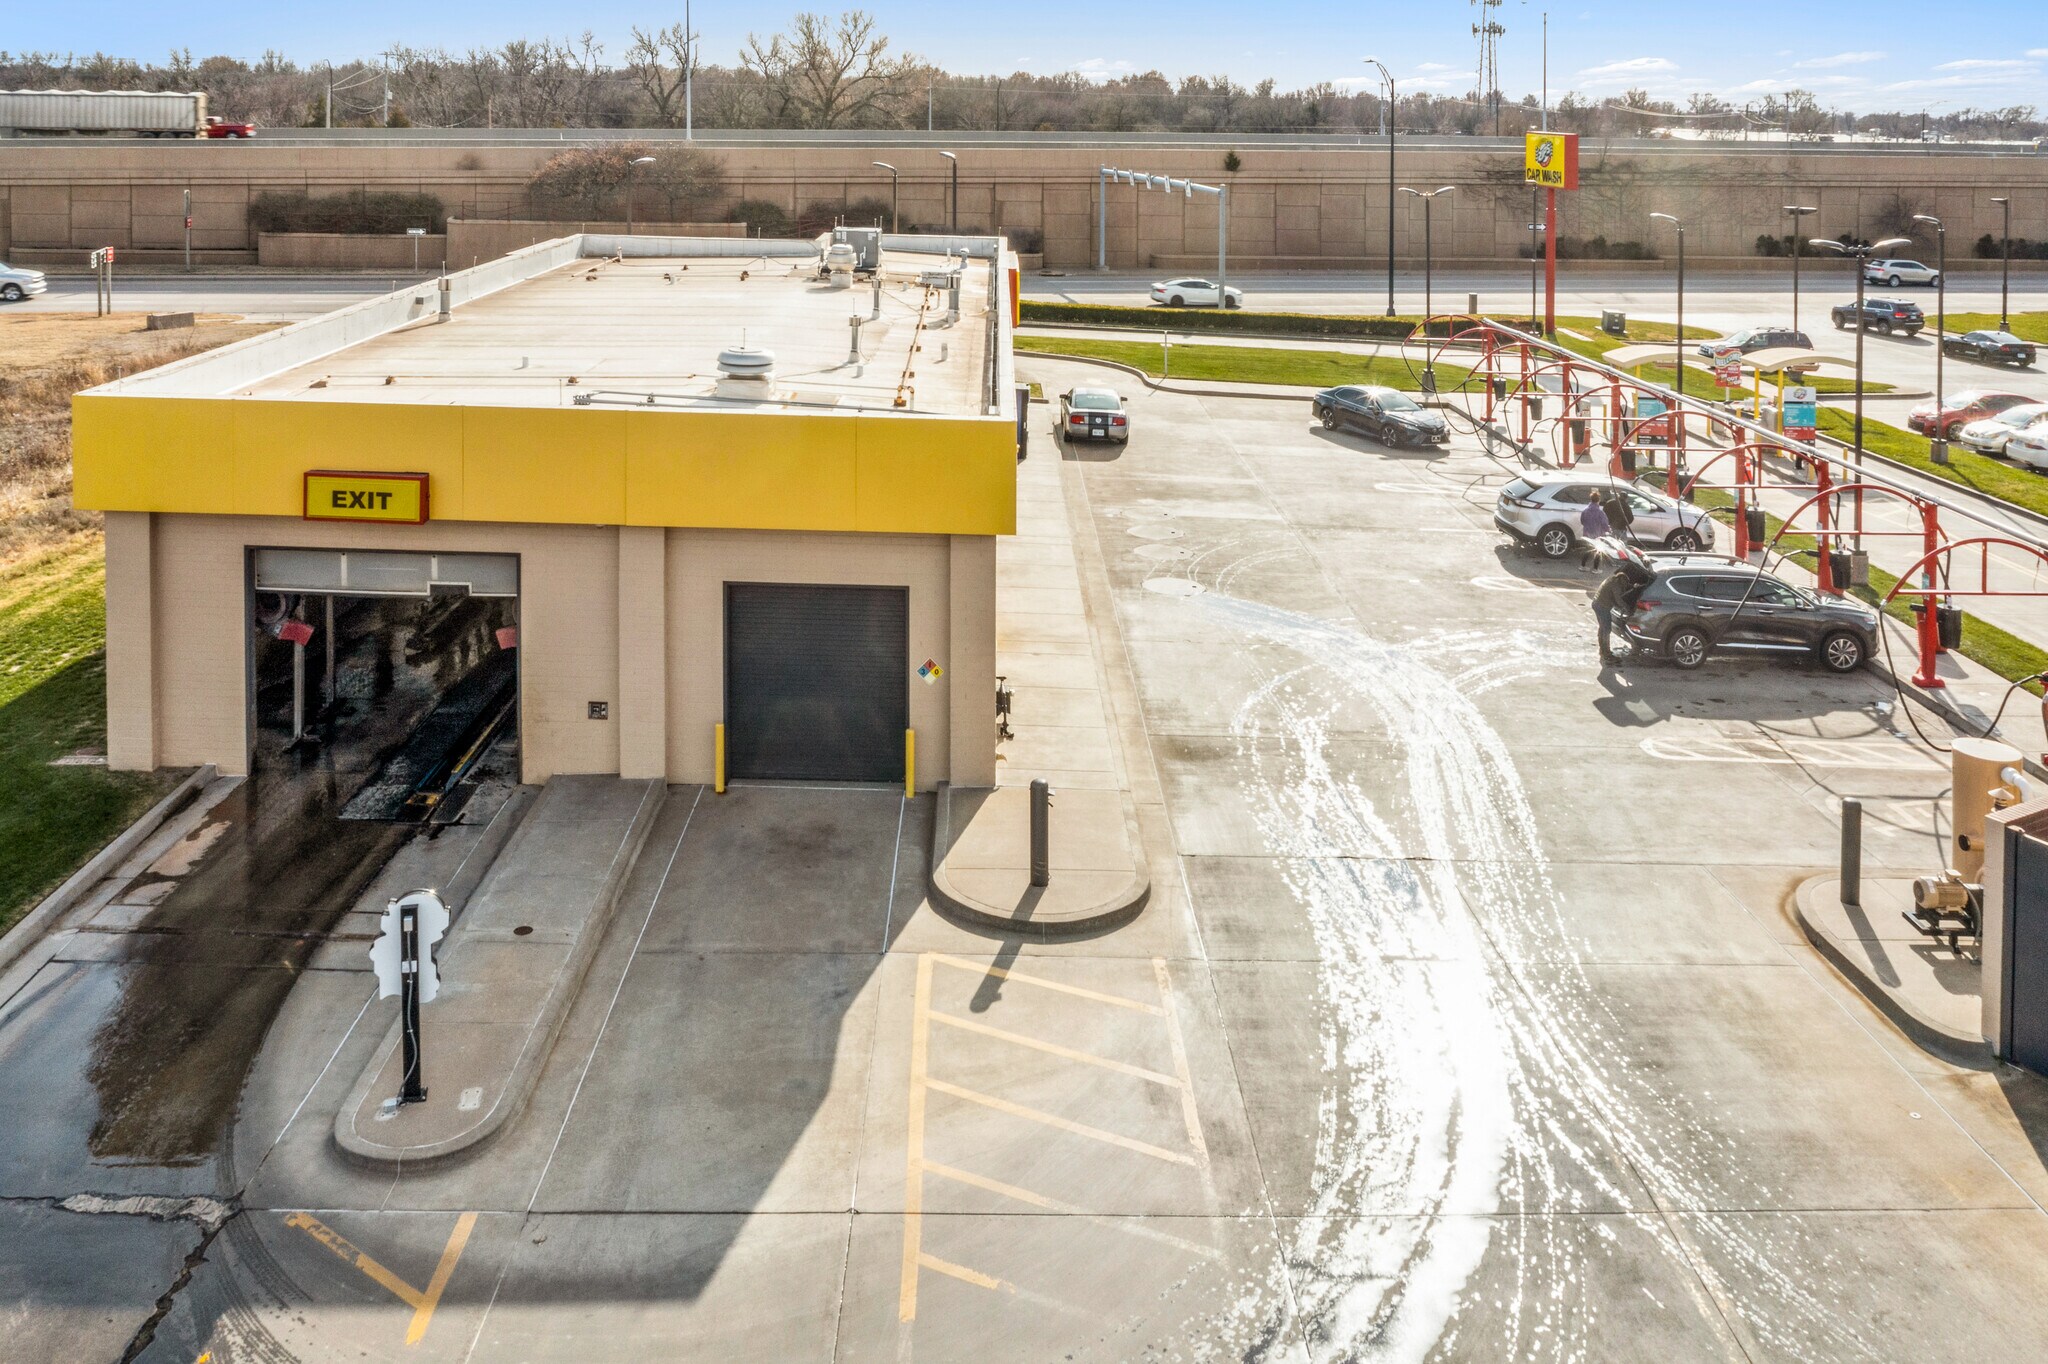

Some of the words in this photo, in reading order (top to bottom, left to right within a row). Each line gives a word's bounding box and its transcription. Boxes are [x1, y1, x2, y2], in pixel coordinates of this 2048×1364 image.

[1527, 168, 1540, 181] CAR
[1542, 170, 1562, 184] WASH
[332, 490, 393, 510] EXIT
